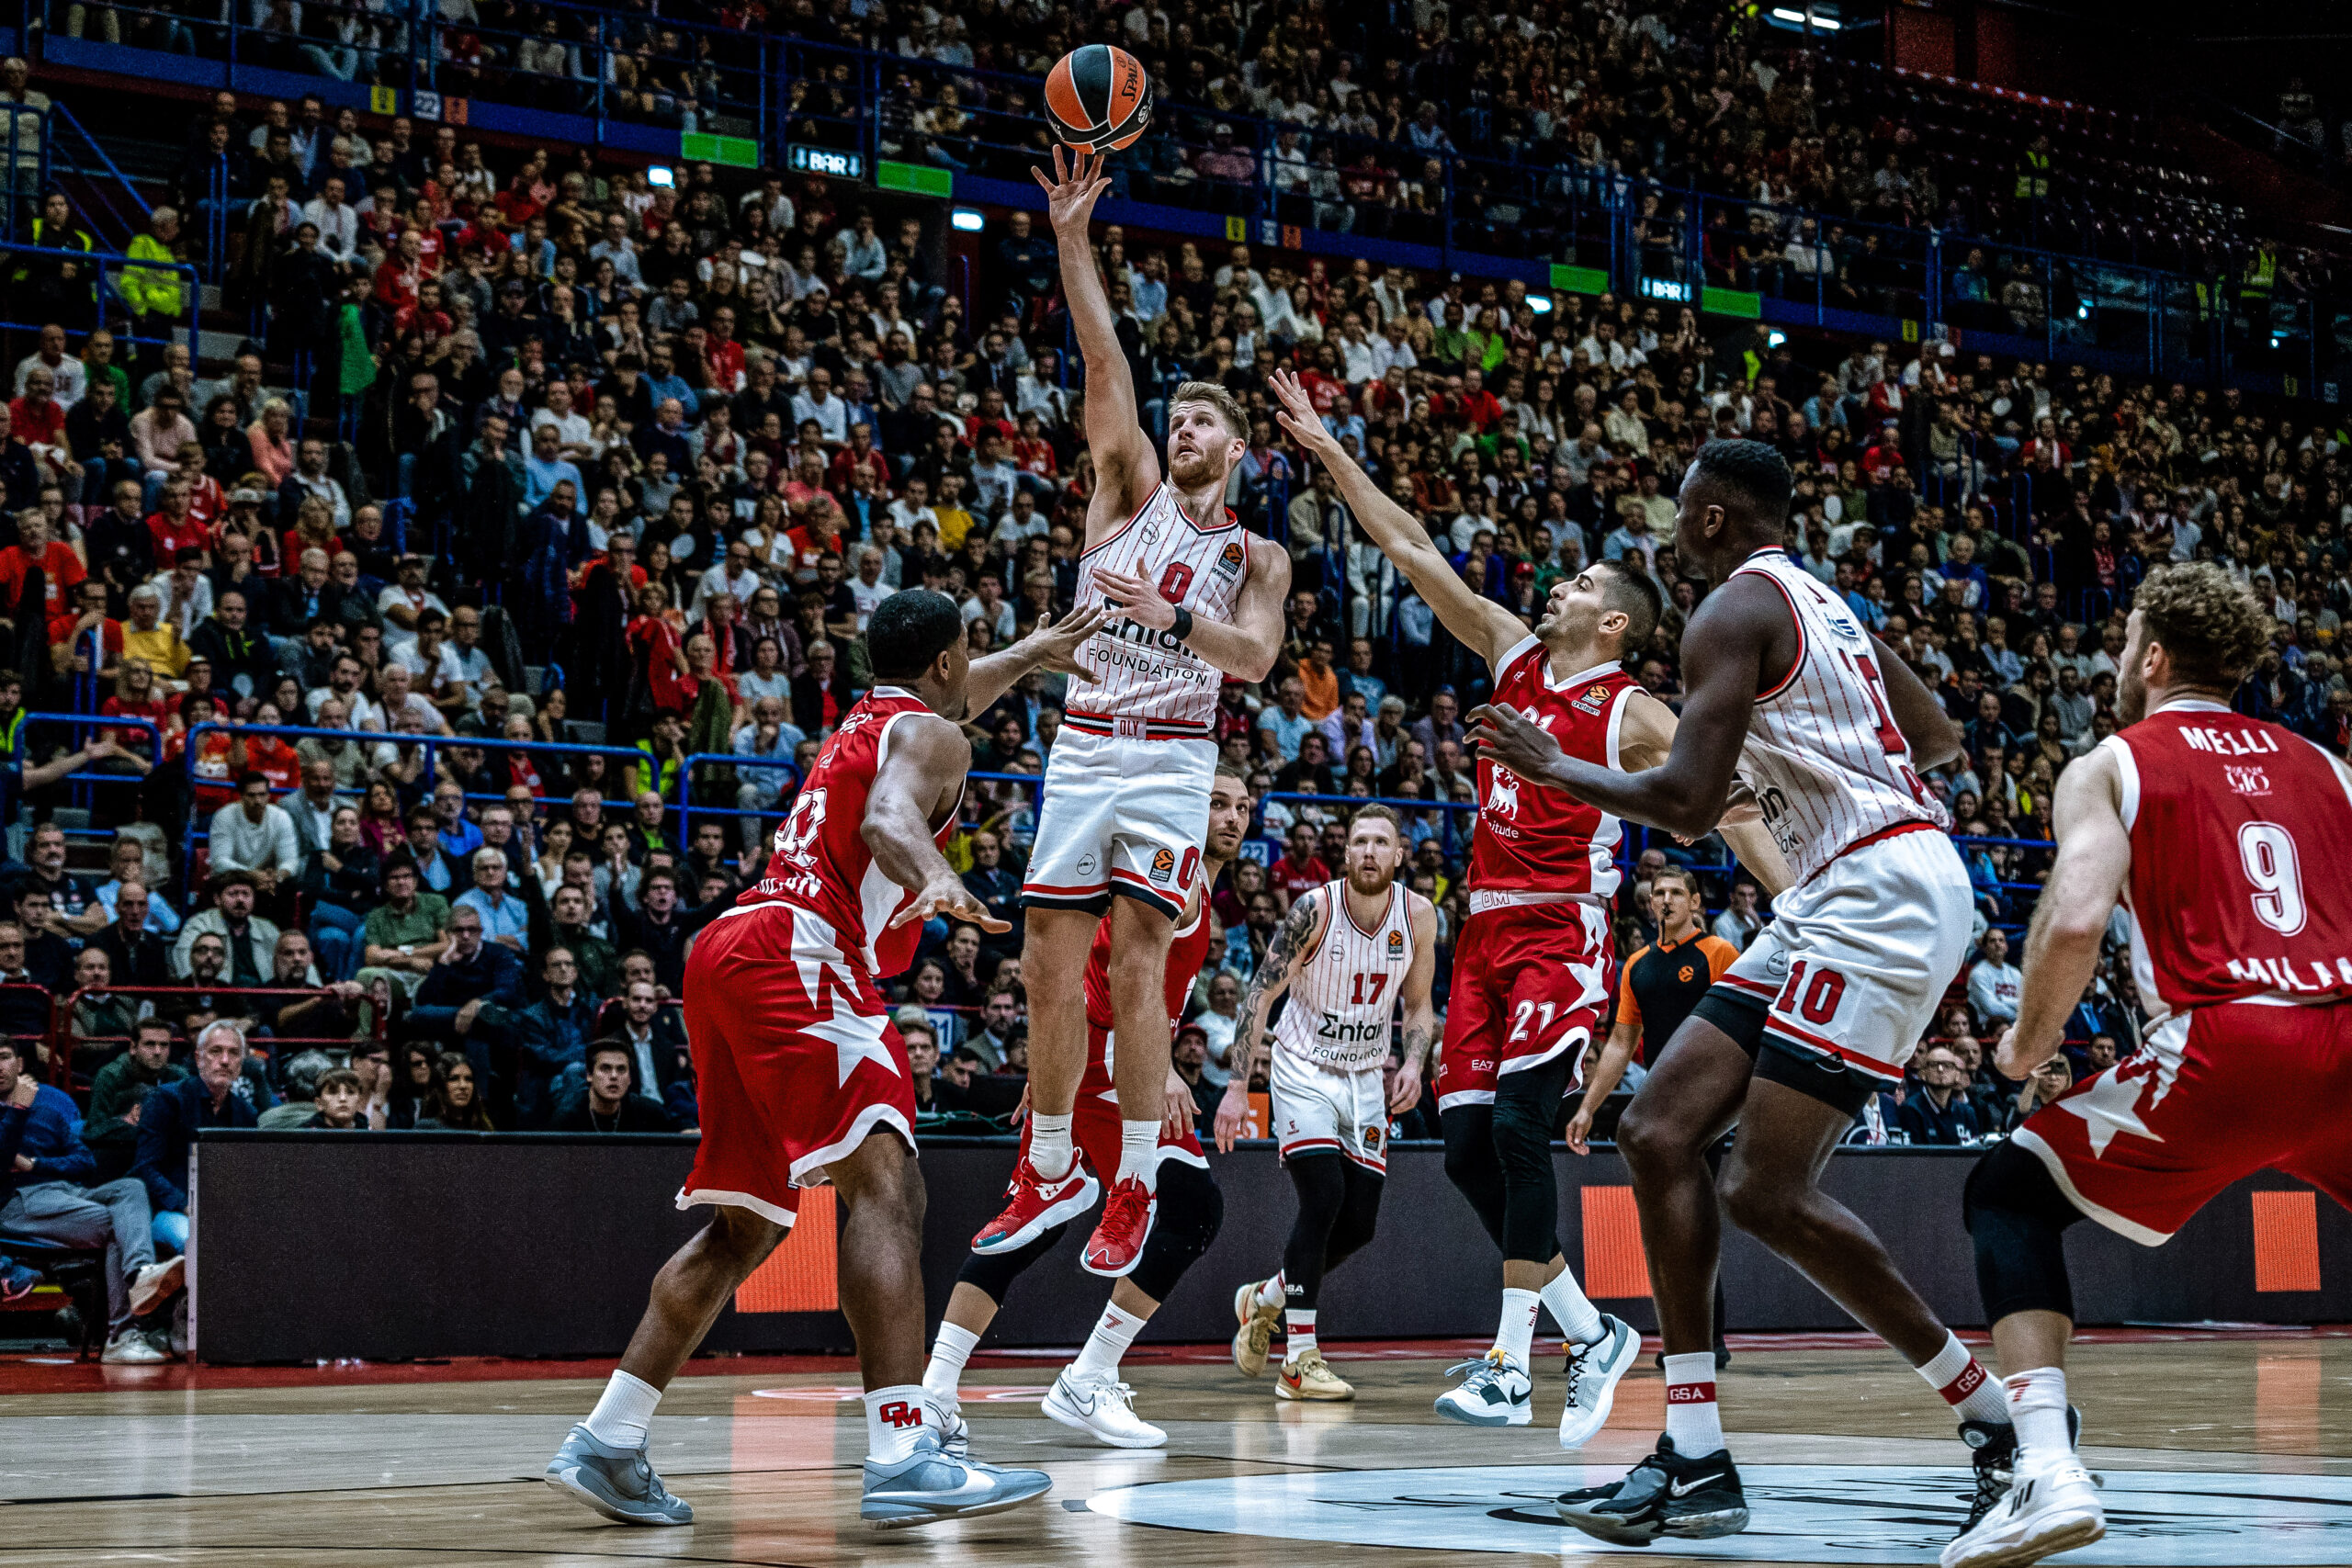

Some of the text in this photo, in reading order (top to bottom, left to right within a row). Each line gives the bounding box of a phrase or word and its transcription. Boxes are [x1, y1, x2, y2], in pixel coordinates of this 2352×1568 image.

[809, 151, 847, 175] BAR
[1652, 279, 1682, 301] BAR
[1159, 561, 1194, 604] 0
[1089, 648, 1207, 687] FOUNDATION
[1119, 719, 1139, 737] OLY
[2178, 726, 2278, 756] MELLI
[1177, 846, 1200, 892] 0
[2237, 821, 2308, 937] 9
[1482, 889, 1510, 908] OM
[1351, 973, 1388, 1005] 17
[1775, 960, 1846, 1025] 10
[1509, 999, 1556, 1043] 21
[1471, 1059, 1495, 1069] EA7
[1957, 1361, 1984, 1393] GSA
[1669, 1387, 1705, 1401] GSA
